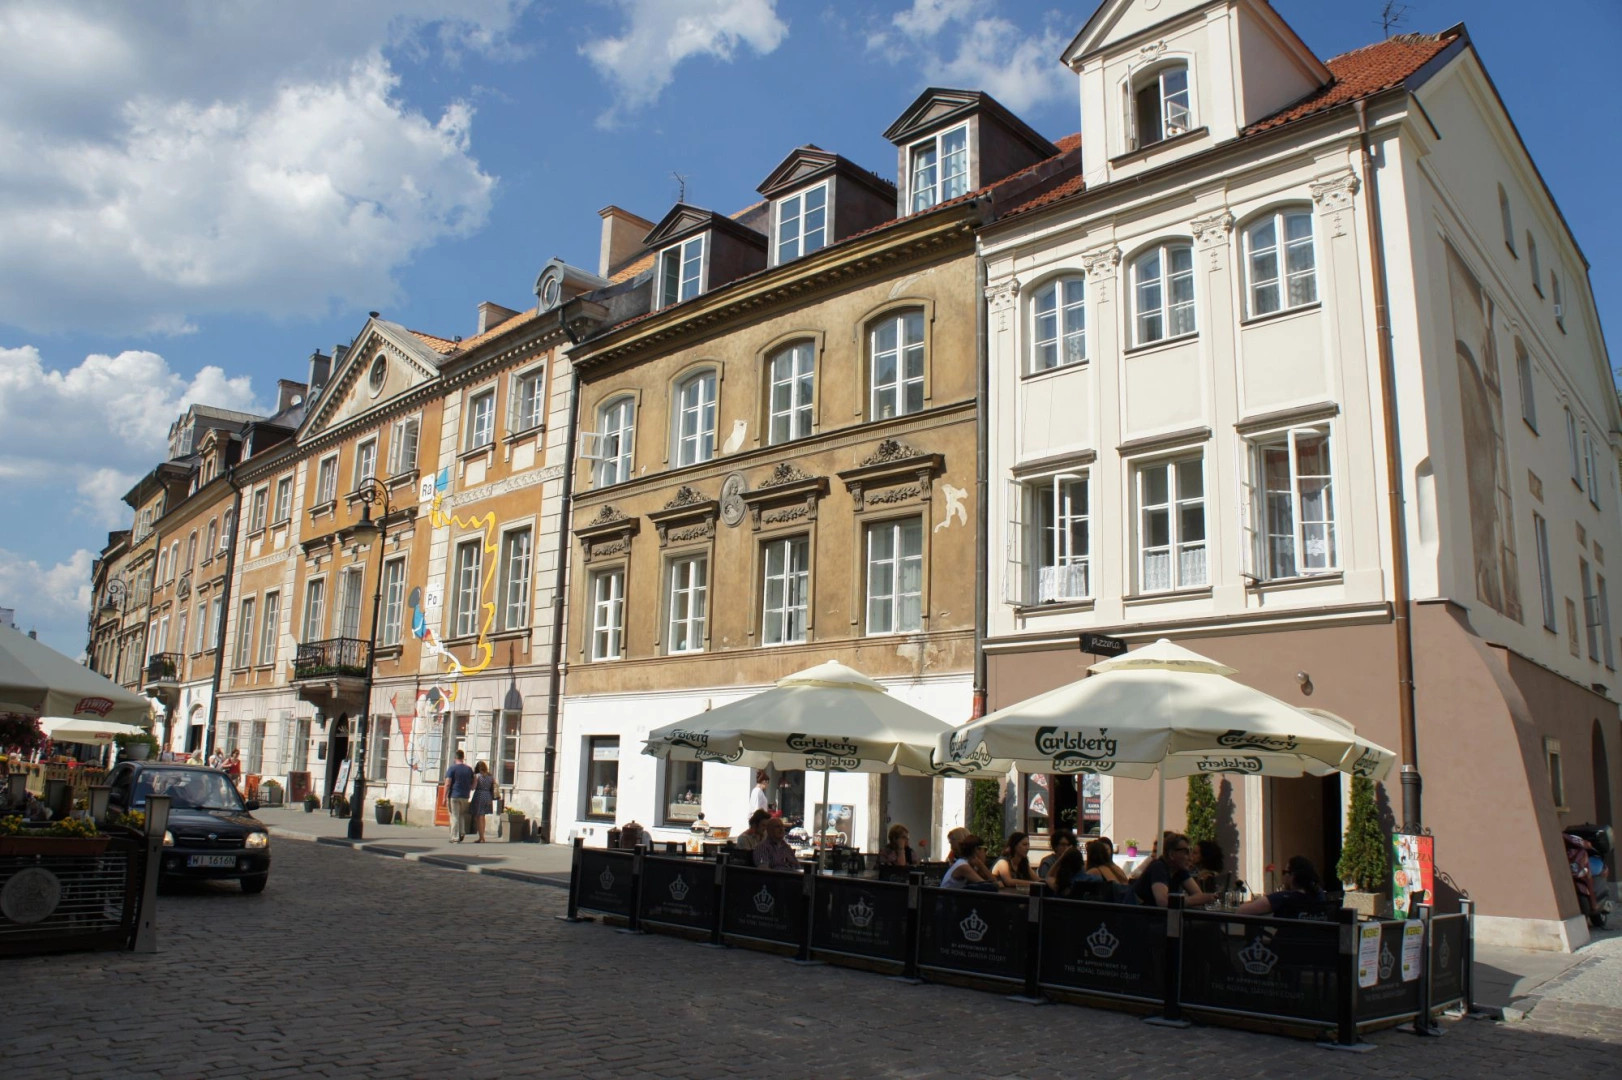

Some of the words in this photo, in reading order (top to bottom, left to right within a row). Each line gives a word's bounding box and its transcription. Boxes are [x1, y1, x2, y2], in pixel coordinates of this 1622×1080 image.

[422, 483, 432, 497] Ra
[427, 593, 437, 606] Po
[786, 732, 858, 755] Carlsberg
[1035, 726, 1117, 757] Carlsberg
[1217, 730, 1298, 750] Carlsberg
